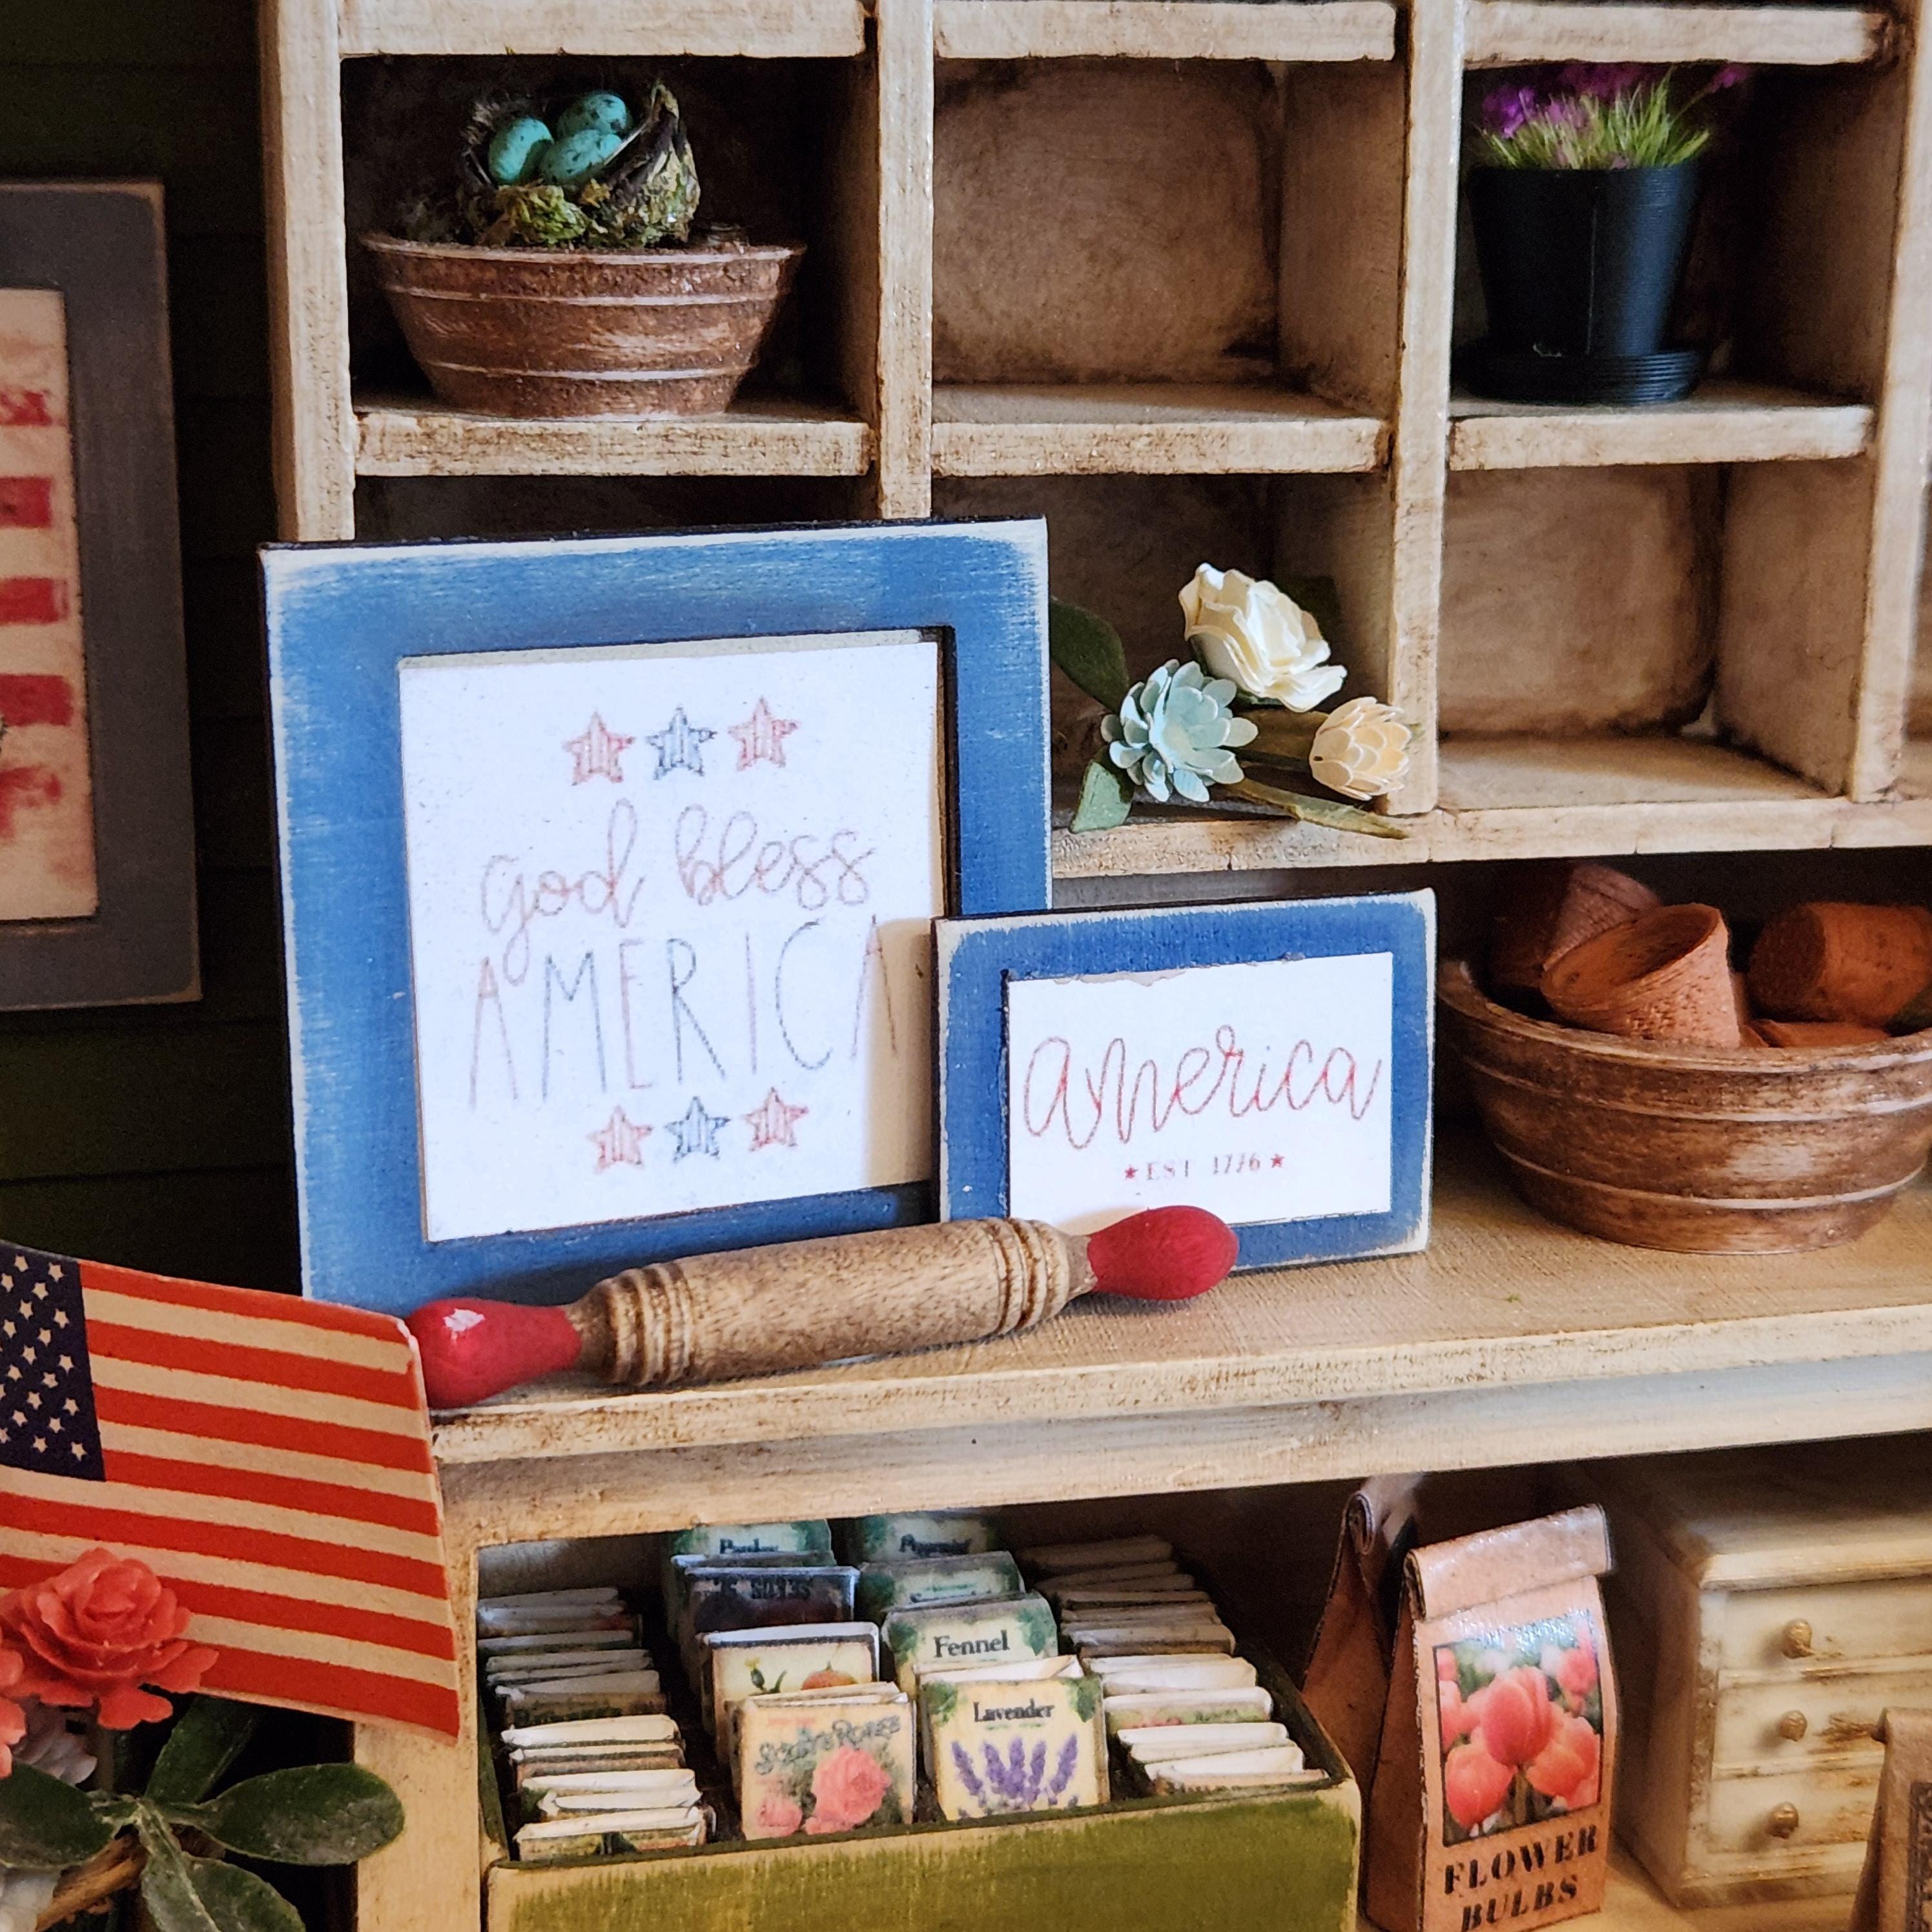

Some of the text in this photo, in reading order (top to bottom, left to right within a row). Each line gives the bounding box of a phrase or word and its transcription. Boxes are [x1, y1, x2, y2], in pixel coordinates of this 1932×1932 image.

[480, 797, 876, 986] god bless
[468, 914, 898, 1111] AMERICA
[1023, 1024, 1382, 1149] america
[933, 1629, 1011, 1658] Fennel
[972, 1698, 1056, 1723] Lavender
[1444, 1824, 1598, 1895] FLOWER
[1461, 1874, 1578, 1932] BULBS
